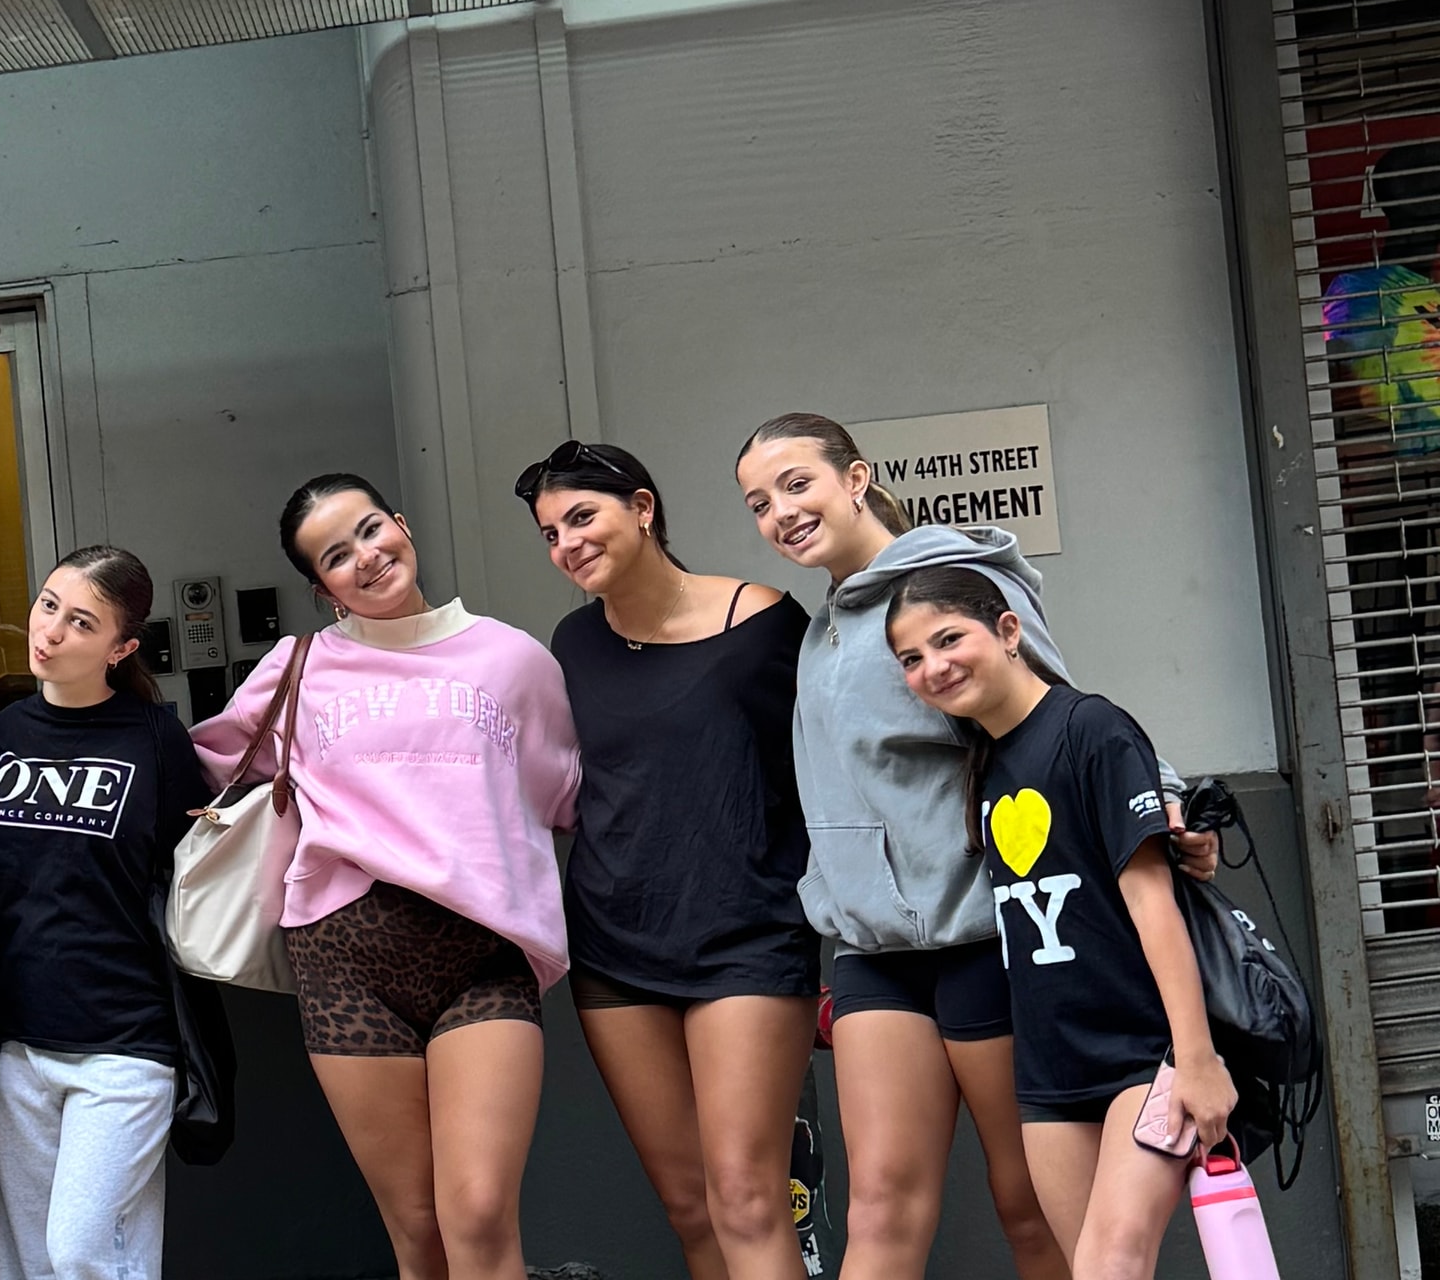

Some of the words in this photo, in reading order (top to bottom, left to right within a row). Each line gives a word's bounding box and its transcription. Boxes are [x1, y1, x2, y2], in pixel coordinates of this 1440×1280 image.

[885, 459, 908, 483] W
[914, 453, 963, 479] 44TH
[969, 446, 1039, 475] STREET
[314, 681, 405, 760] NEW
[418, 678, 517, 766] YORK
[34, 812, 107, 827] COMPANY
